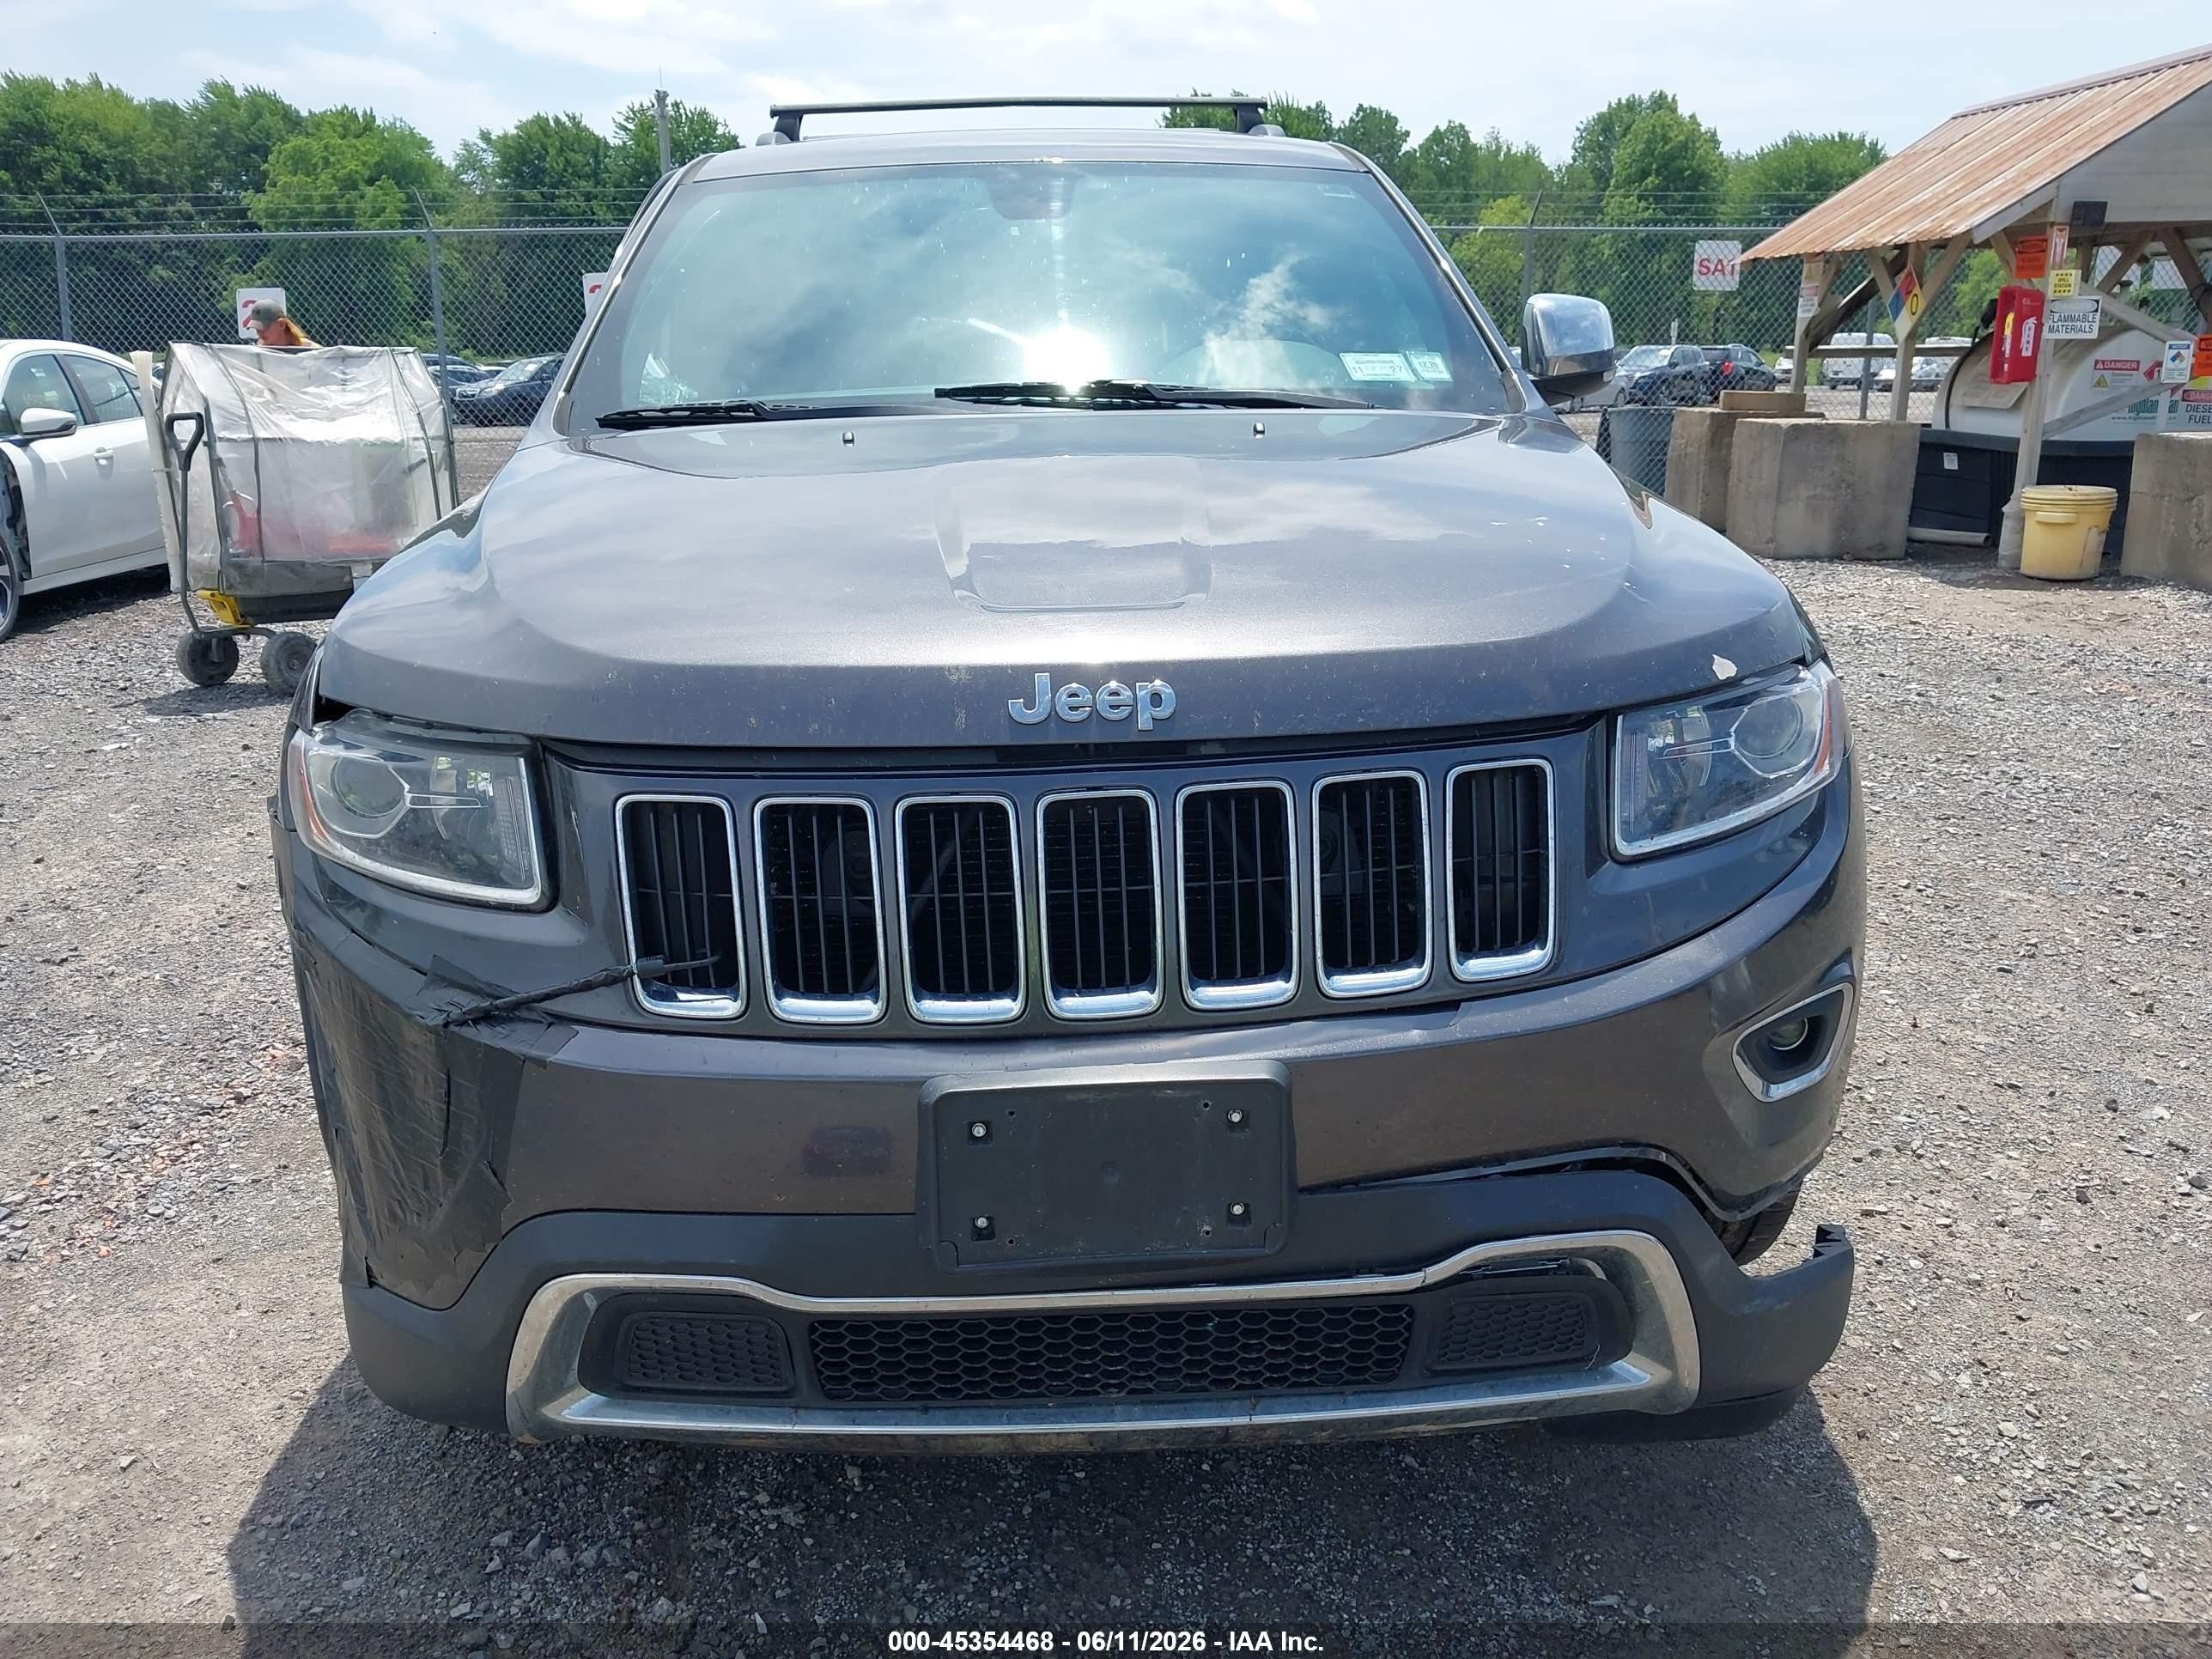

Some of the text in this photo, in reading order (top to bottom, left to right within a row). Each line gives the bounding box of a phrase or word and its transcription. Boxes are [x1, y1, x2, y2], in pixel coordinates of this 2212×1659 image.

[2048, 313, 2097, 324] FLAMMABLE
[2048, 324, 2094, 334] MATERIALS
[2190, 391, 2212, 400] DANG
[2188, 414, 2212, 424] FUEL
[1008, 672, 1176, 731] Jeep
